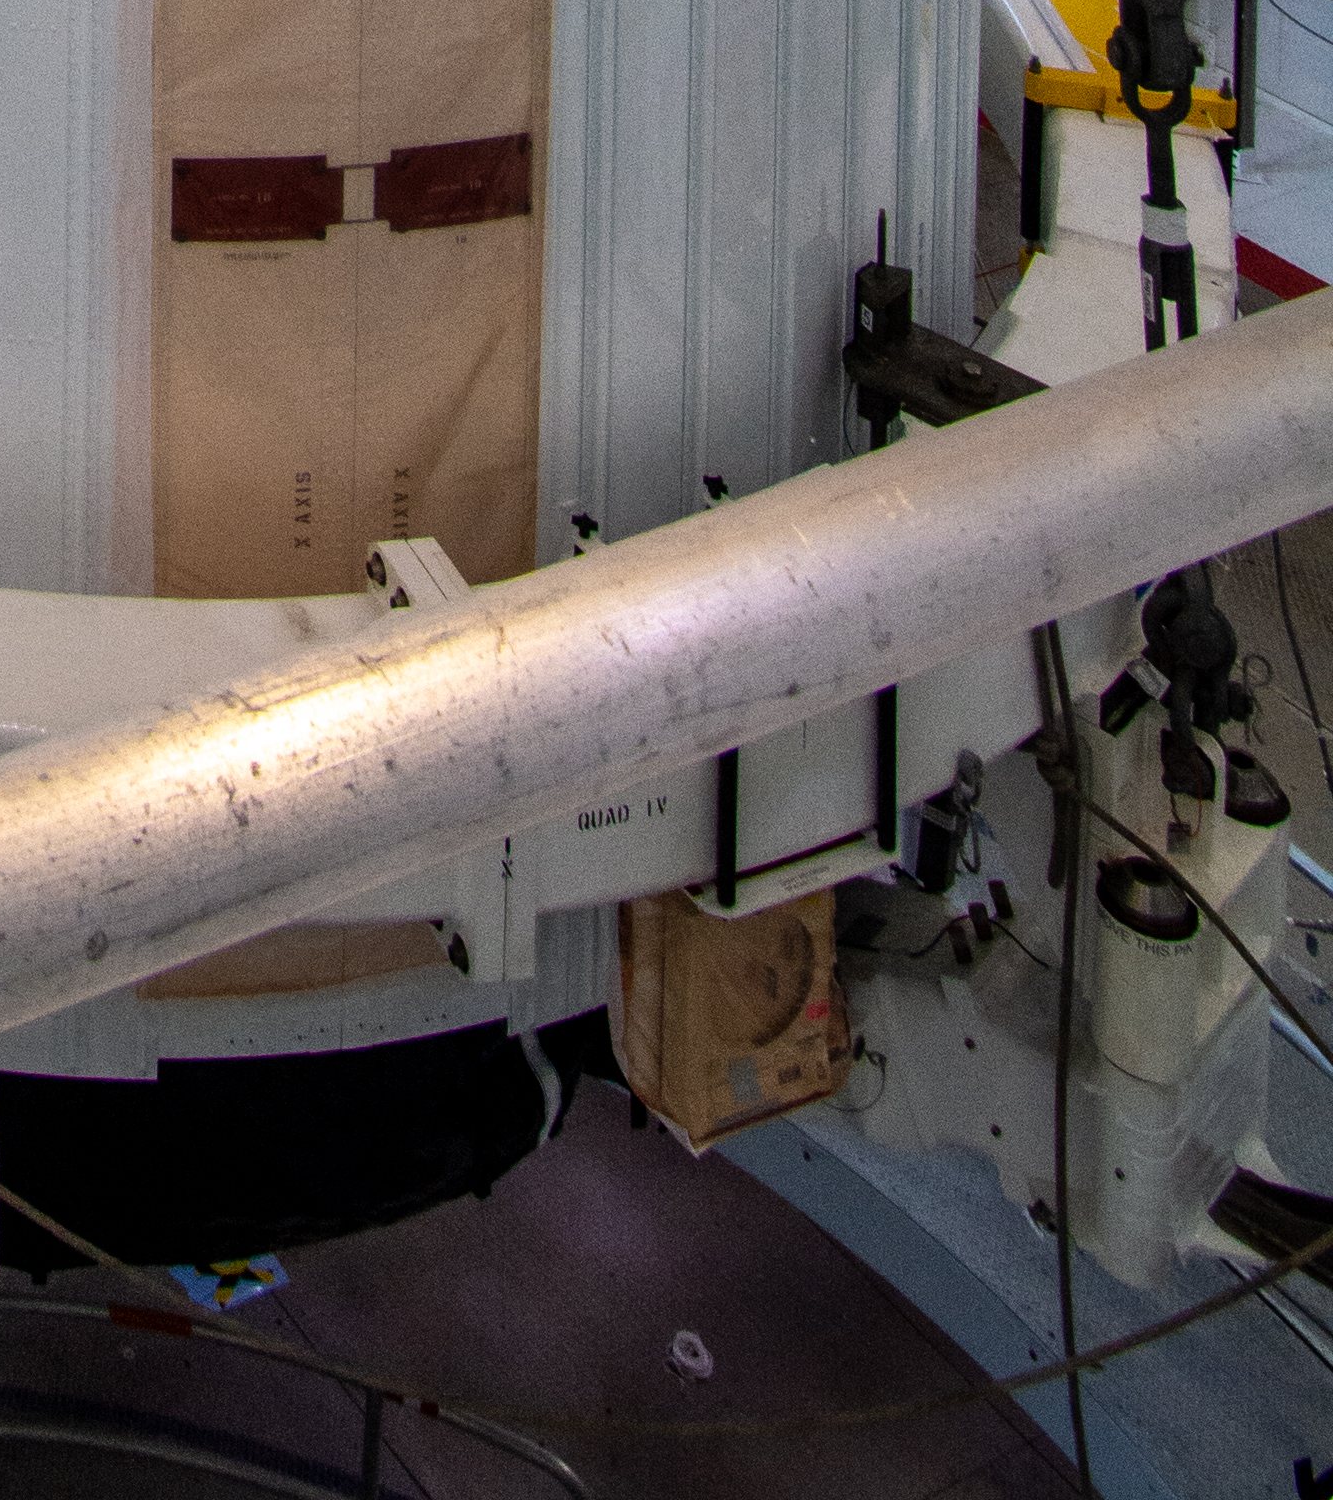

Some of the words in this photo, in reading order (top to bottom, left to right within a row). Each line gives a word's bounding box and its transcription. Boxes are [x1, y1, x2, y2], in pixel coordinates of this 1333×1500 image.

[393, 467, 411, 479] X
[294, 471, 312, 525] AXIS
[294, 536, 312, 549] X
[577, 804, 630, 832] QUAD
[647, 795, 668, 817] IV
[1136, 937, 1171, 958] THIS
